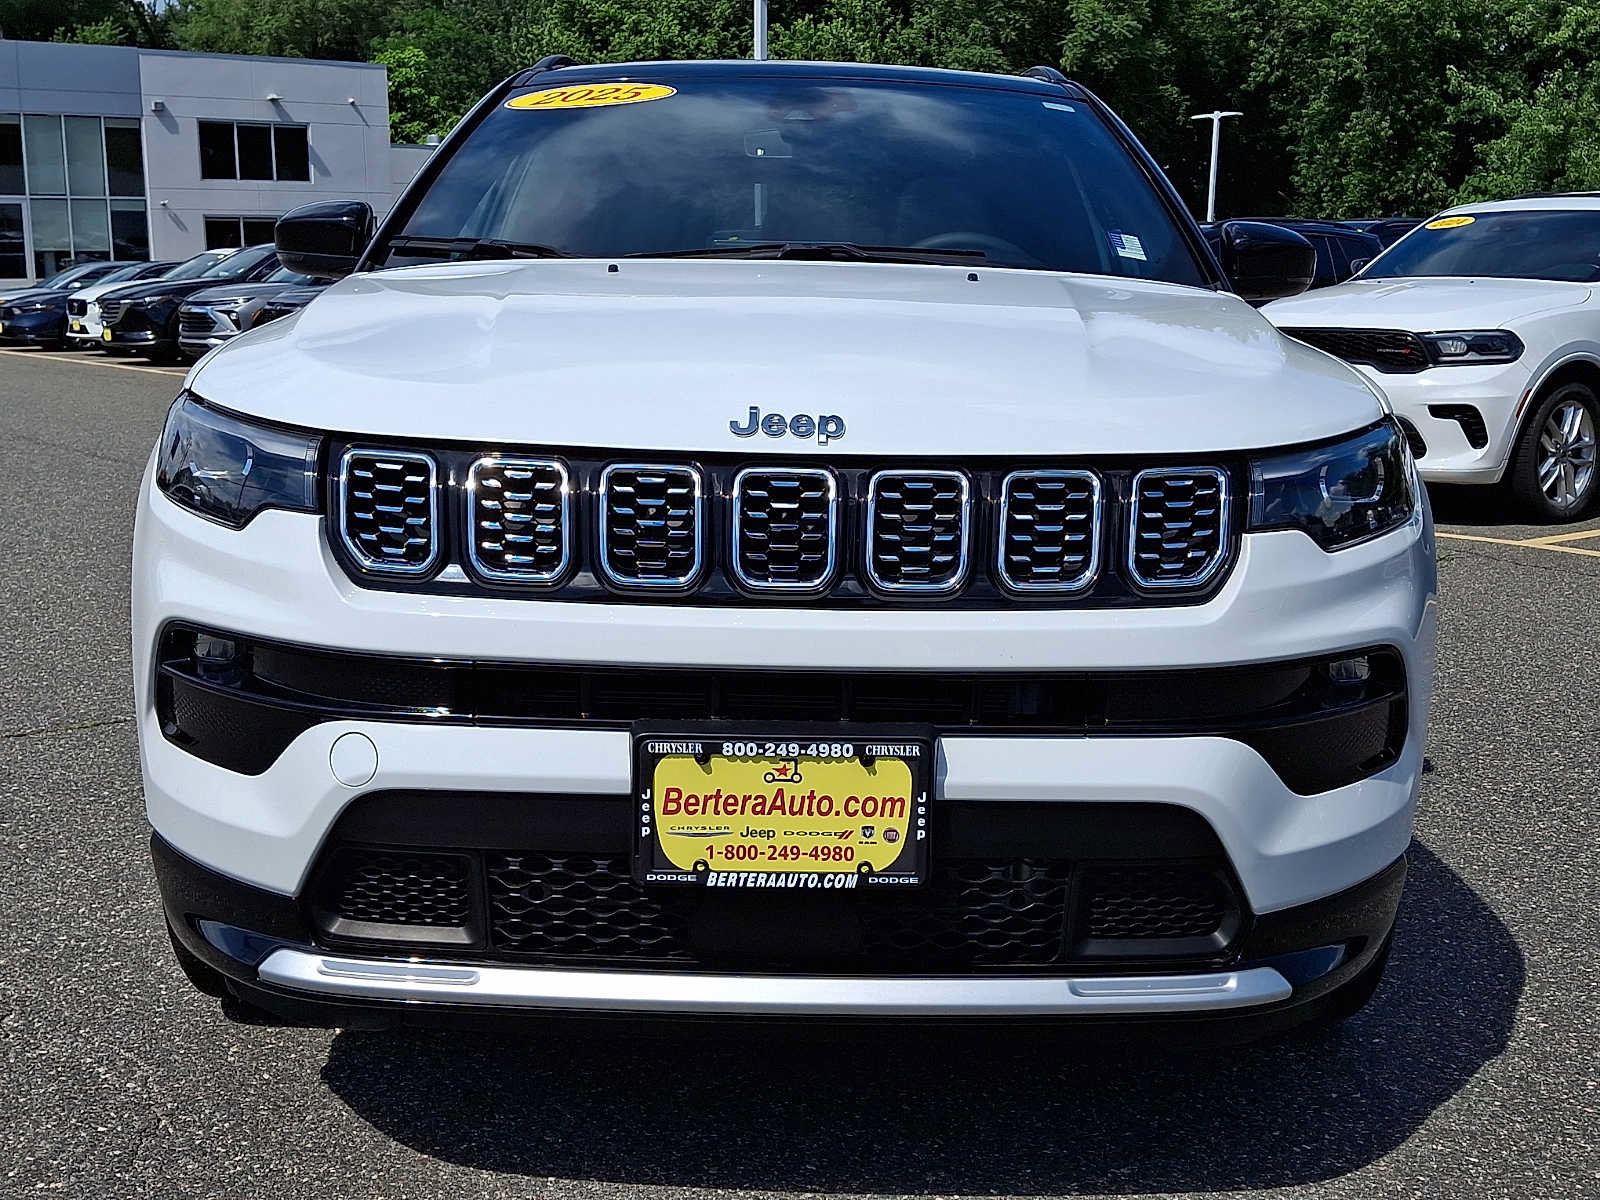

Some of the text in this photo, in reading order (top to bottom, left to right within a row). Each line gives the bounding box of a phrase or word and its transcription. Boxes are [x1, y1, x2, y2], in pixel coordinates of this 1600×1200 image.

[530, 86, 652, 105] 2025
[729, 406, 846, 446] Jeep
[648, 742, 703, 754] CHRYSLER
[722, 742, 854, 758] 800-249-4980
[865, 745, 920, 757] CHRYSLER
[662, 787, 905, 818] BerteraAuto.com
[641, 788, 650, 838] Jeep
[917, 791, 926, 841] Jeep
[740, 826, 776, 840] Jeep
[705, 845, 855, 862] 1-800-249-4980
[646, 874, 697, 882] DODGE
[706, 872, 858, 889] BERTERAAUTO.COM
